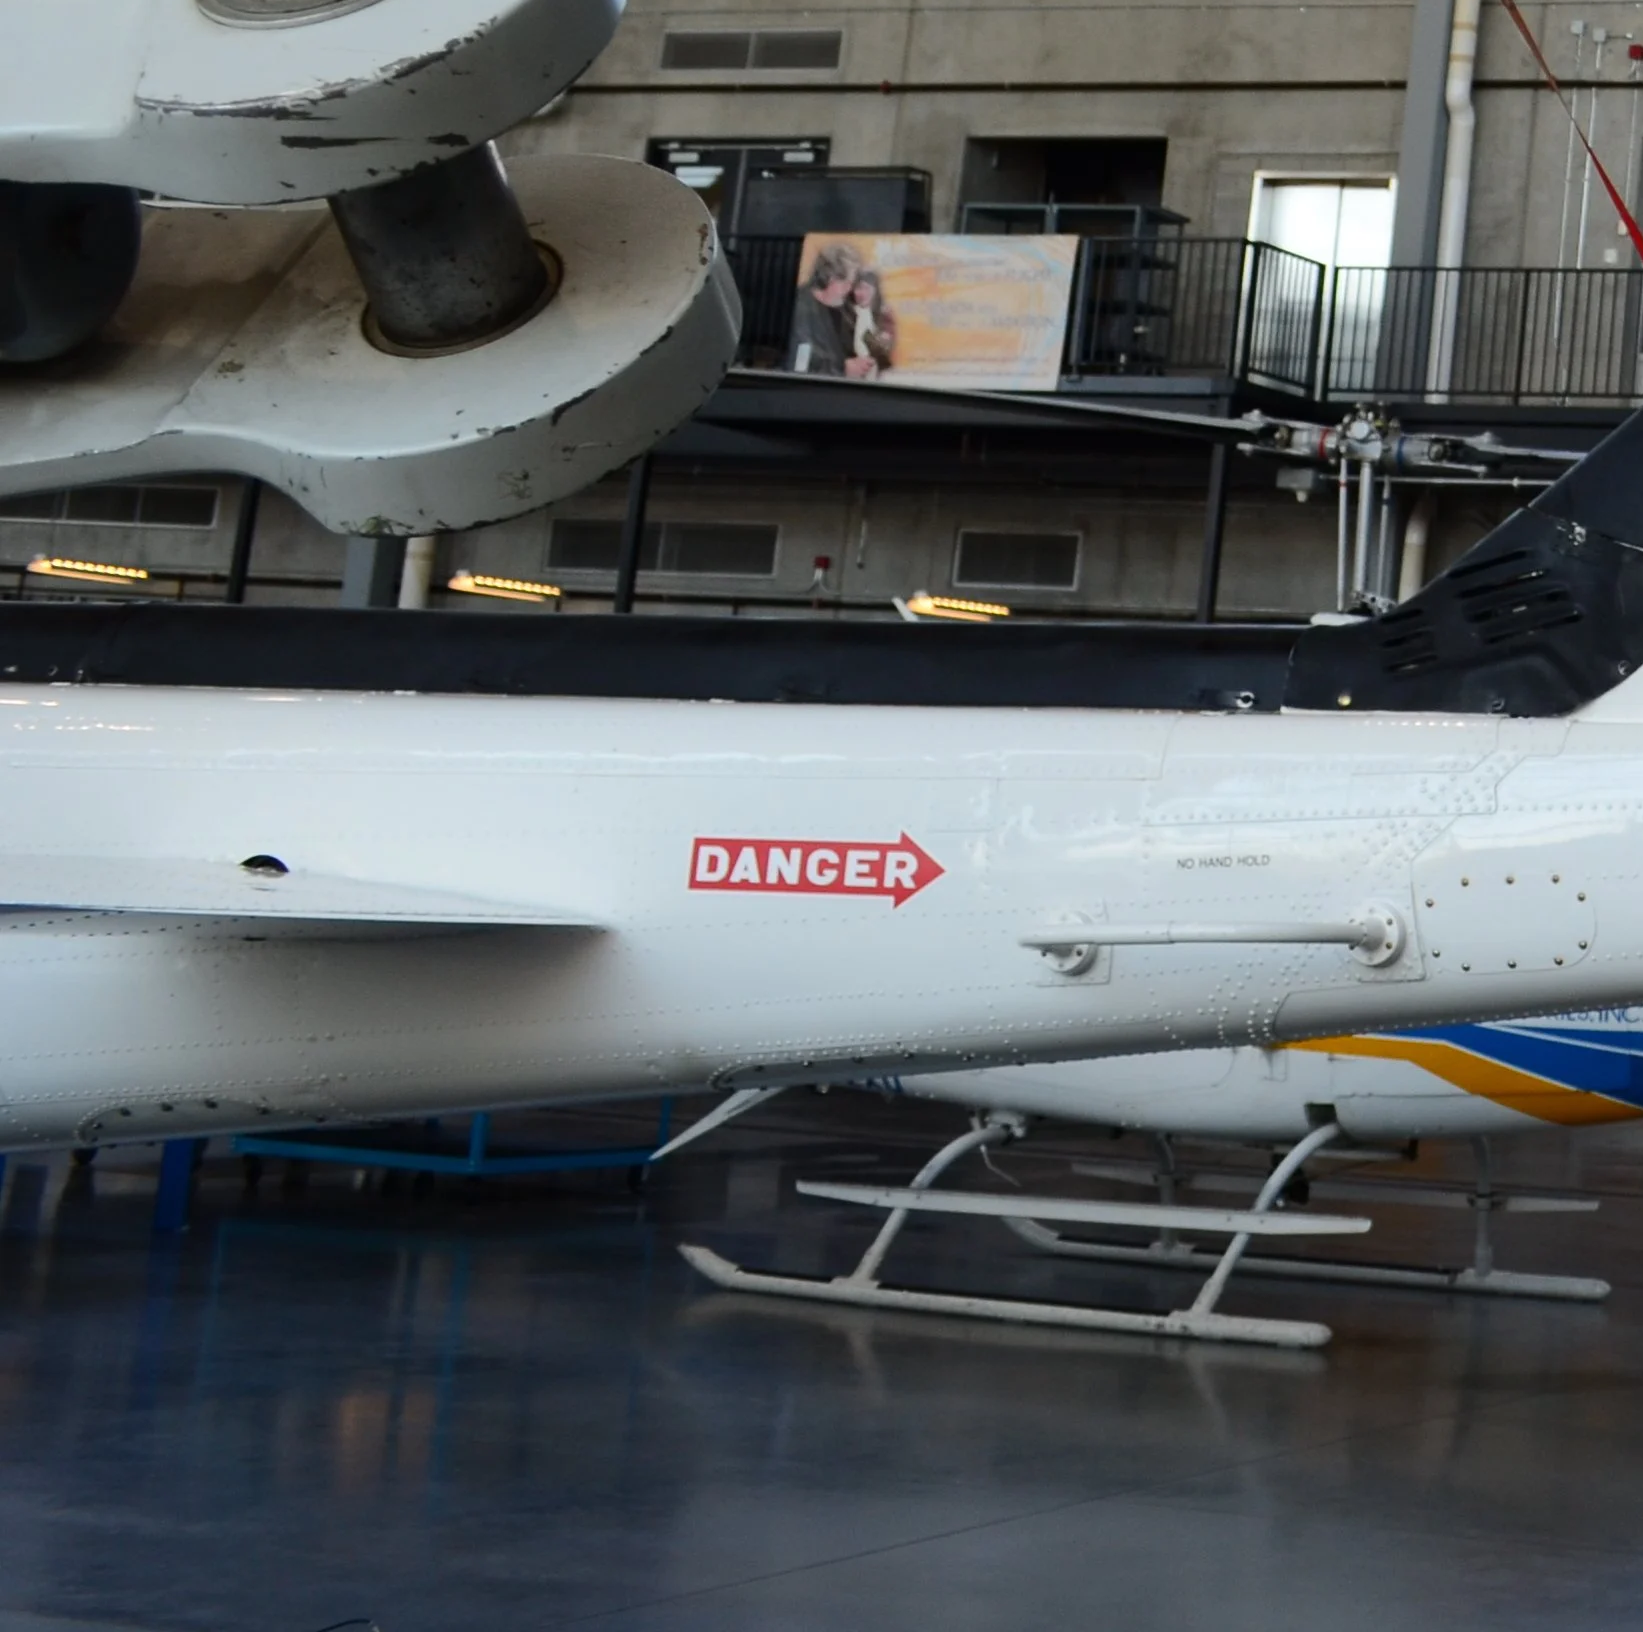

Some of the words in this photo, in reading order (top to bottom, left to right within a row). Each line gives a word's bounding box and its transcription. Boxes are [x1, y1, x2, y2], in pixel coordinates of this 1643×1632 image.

[695, 845, 919, 889] DANGER
[1177, 858, 1195, 869] NO
[1198, 856, 1233, 868] HAND
[1237, 854, 1271, 867] HOLD
